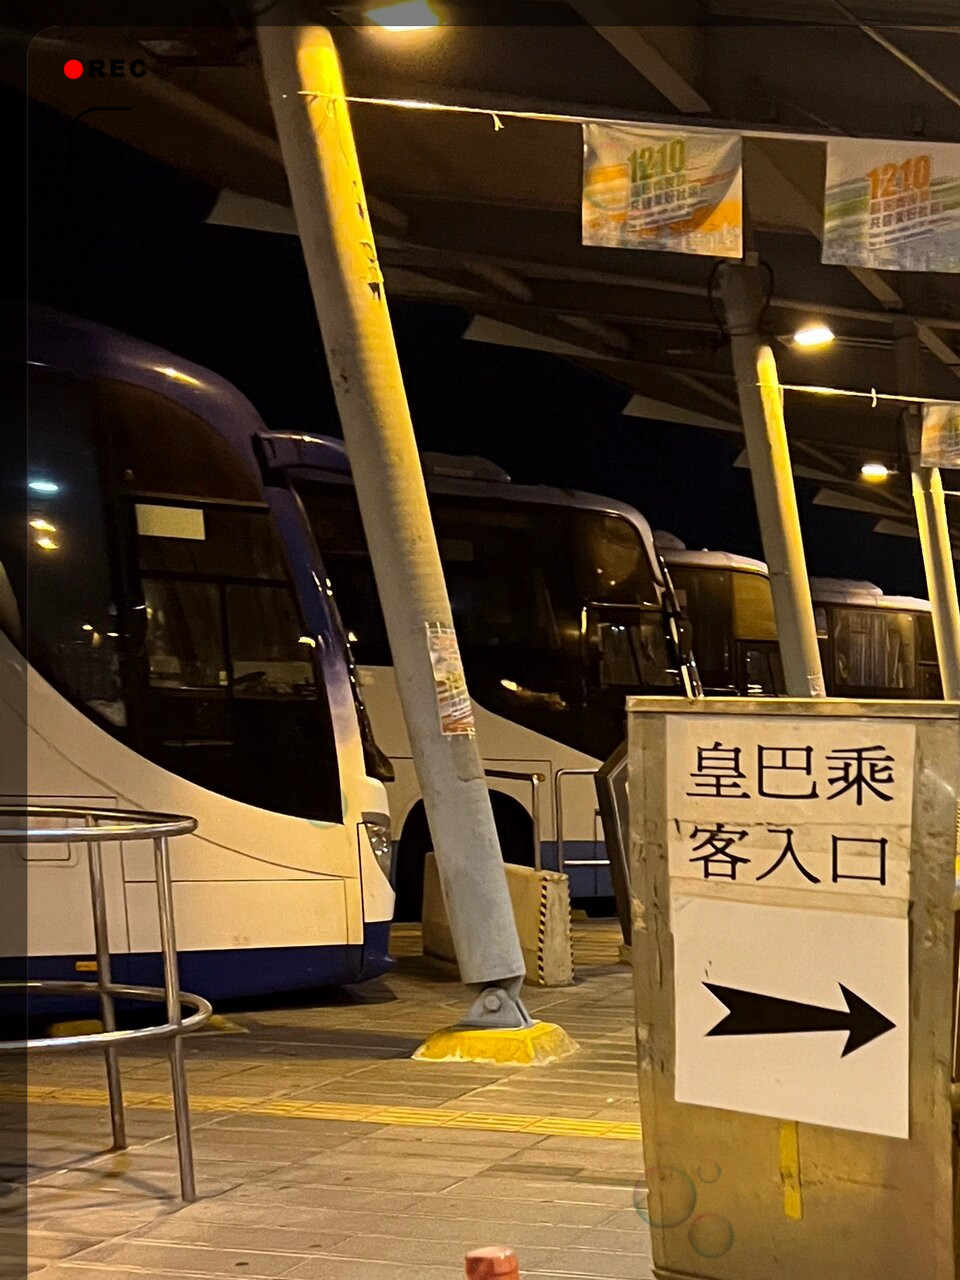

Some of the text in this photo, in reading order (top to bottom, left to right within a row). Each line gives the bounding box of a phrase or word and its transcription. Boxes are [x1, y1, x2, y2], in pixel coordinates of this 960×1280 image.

[627, 138, 687, 184] 1210
[866, 154, 931, 201] 1210
[686, 741, 896, 805] 皇巴乘
[688, 823, 889, 886] 客入口
